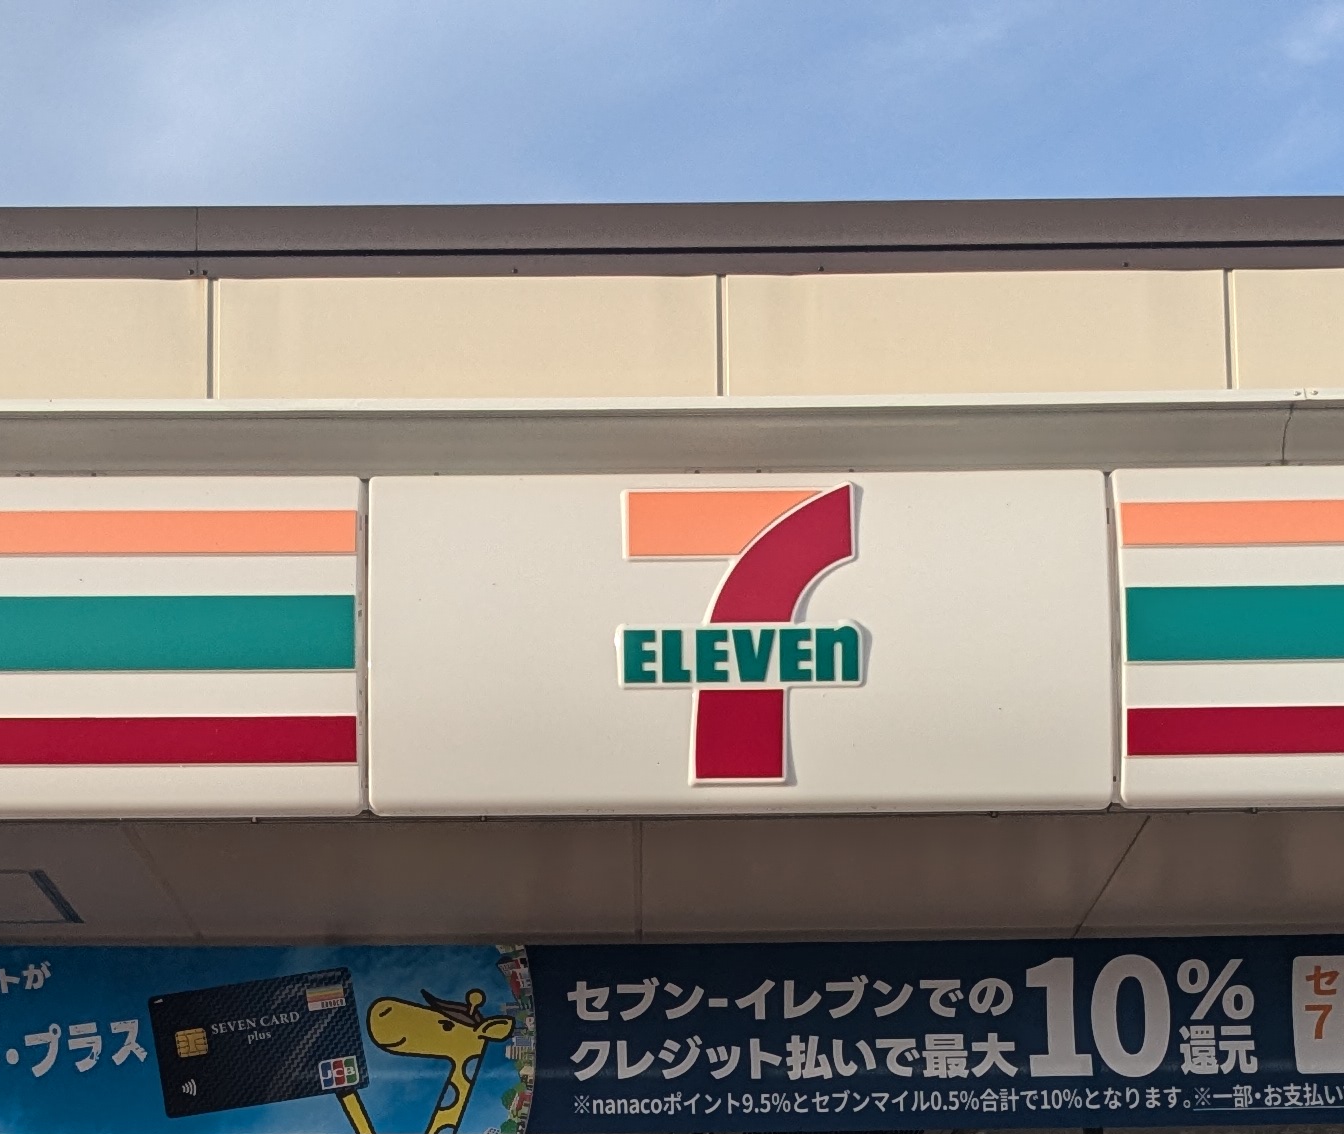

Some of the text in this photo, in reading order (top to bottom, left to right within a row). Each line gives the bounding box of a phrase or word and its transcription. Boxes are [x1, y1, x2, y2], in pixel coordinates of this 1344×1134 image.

[211, 1011, 300, 1035] SEVEN CARD
[247, 1030, 272, 1045] plus
[1026, 953, 1254, 1078] 10%
[570, 1034, 1019, 1080] クレジット払いで最大
[1179, 1025, 1258, 1075] 還元
